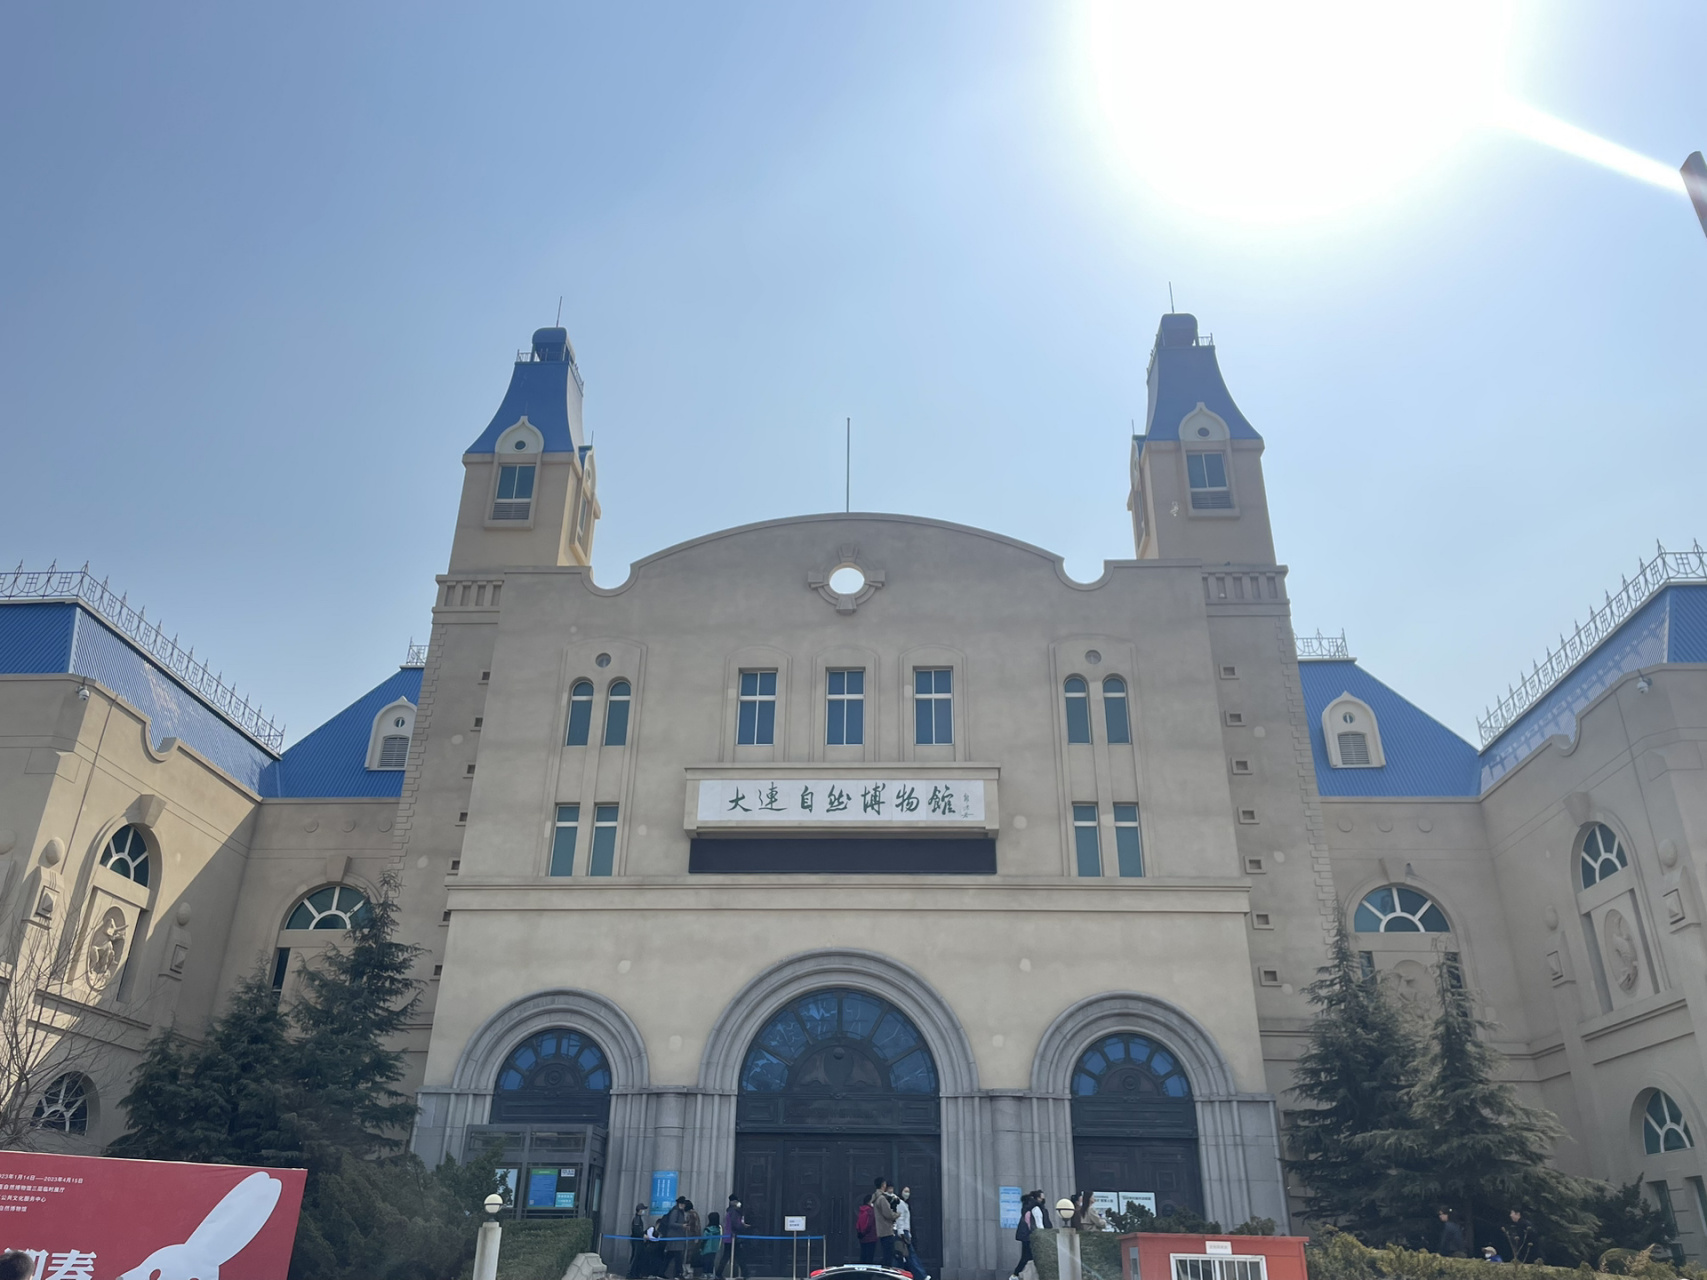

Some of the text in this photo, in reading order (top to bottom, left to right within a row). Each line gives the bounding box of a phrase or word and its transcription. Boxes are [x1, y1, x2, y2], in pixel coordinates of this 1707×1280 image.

[0, 1194, 47, 1203] 公共文化服务中心
